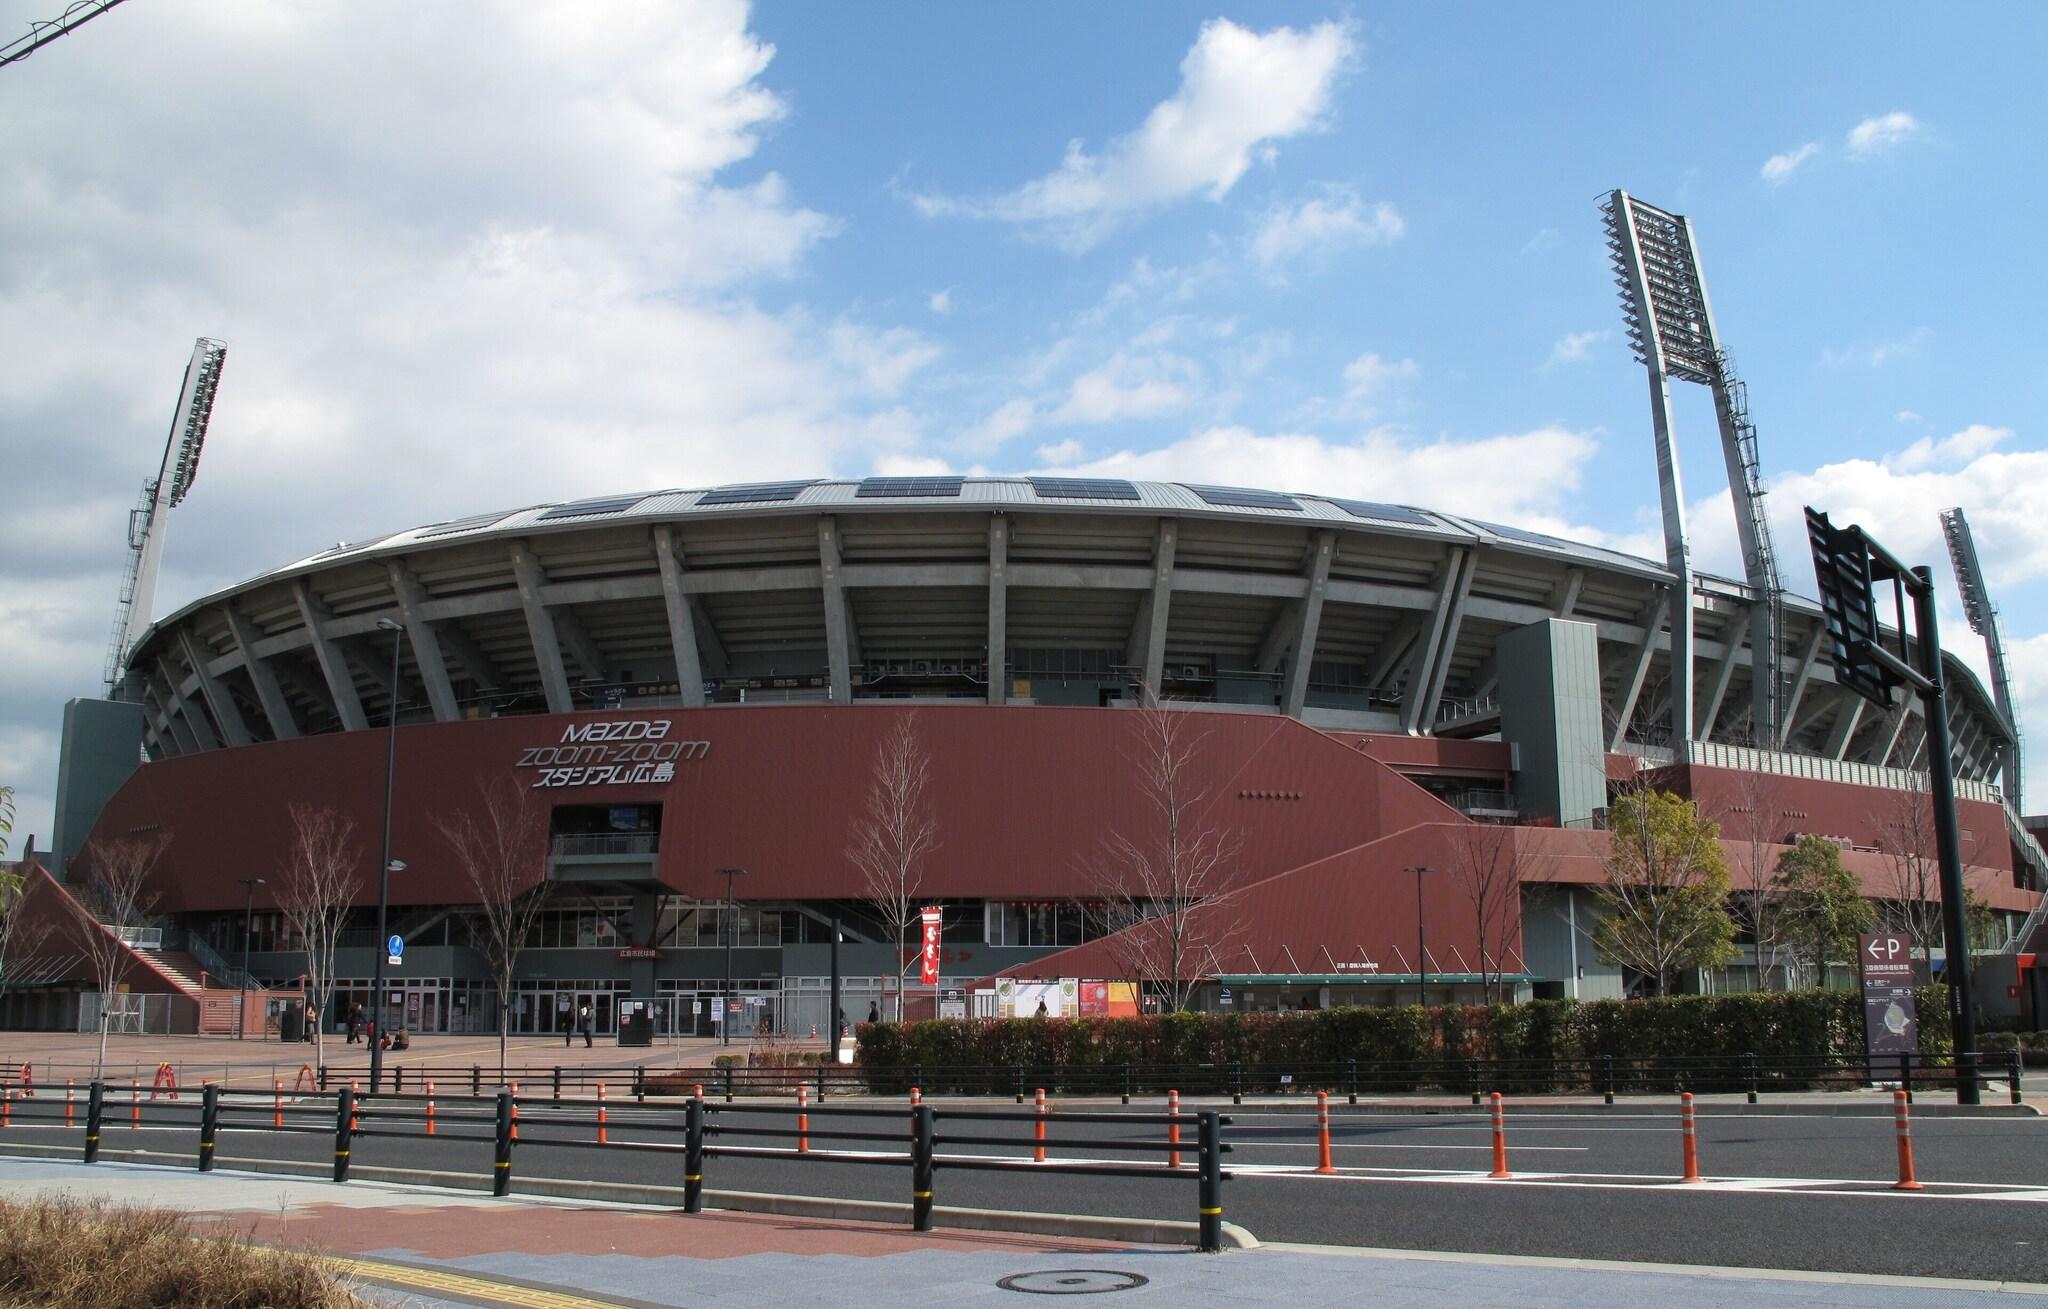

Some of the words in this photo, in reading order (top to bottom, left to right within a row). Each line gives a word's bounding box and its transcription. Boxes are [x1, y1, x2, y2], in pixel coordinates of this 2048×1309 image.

[532, 761, 676, 788] スタジアム広島
[1887, 938, 1900, 960] P
